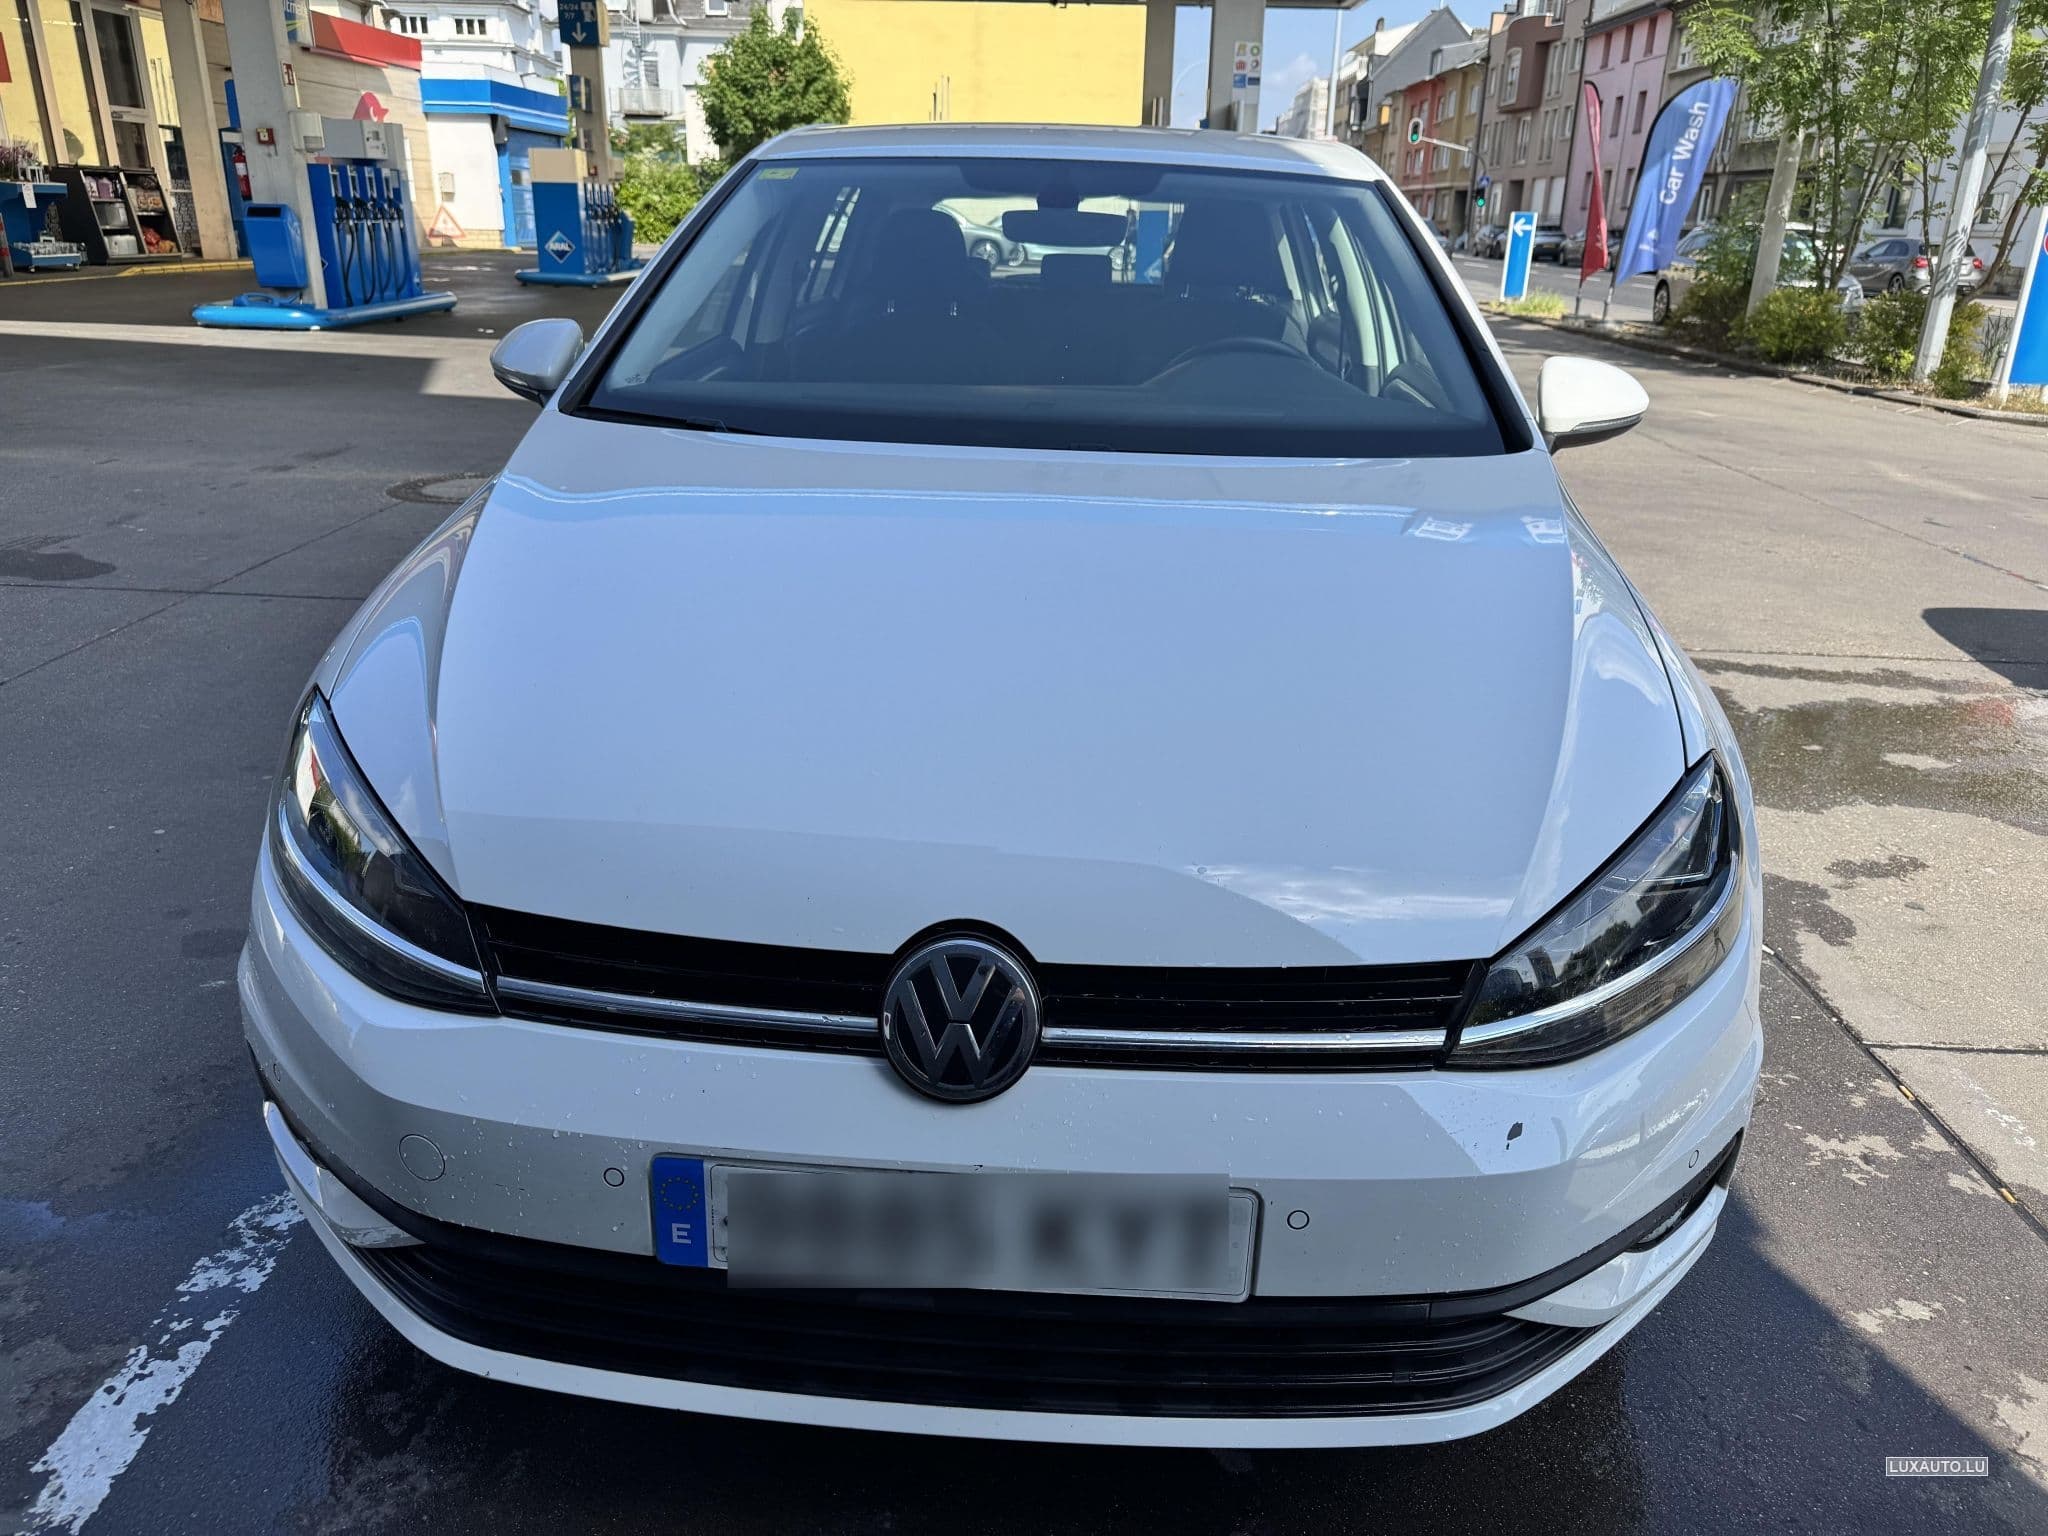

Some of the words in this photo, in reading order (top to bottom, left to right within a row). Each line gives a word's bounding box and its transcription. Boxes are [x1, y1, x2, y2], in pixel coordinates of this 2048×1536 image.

[1672, 101, 1709, 162] Wash
[1660, 165, 1685, 205] Car
[549, 241, 571, 251] ARAL
[671, 1222, 692, 1244] E
